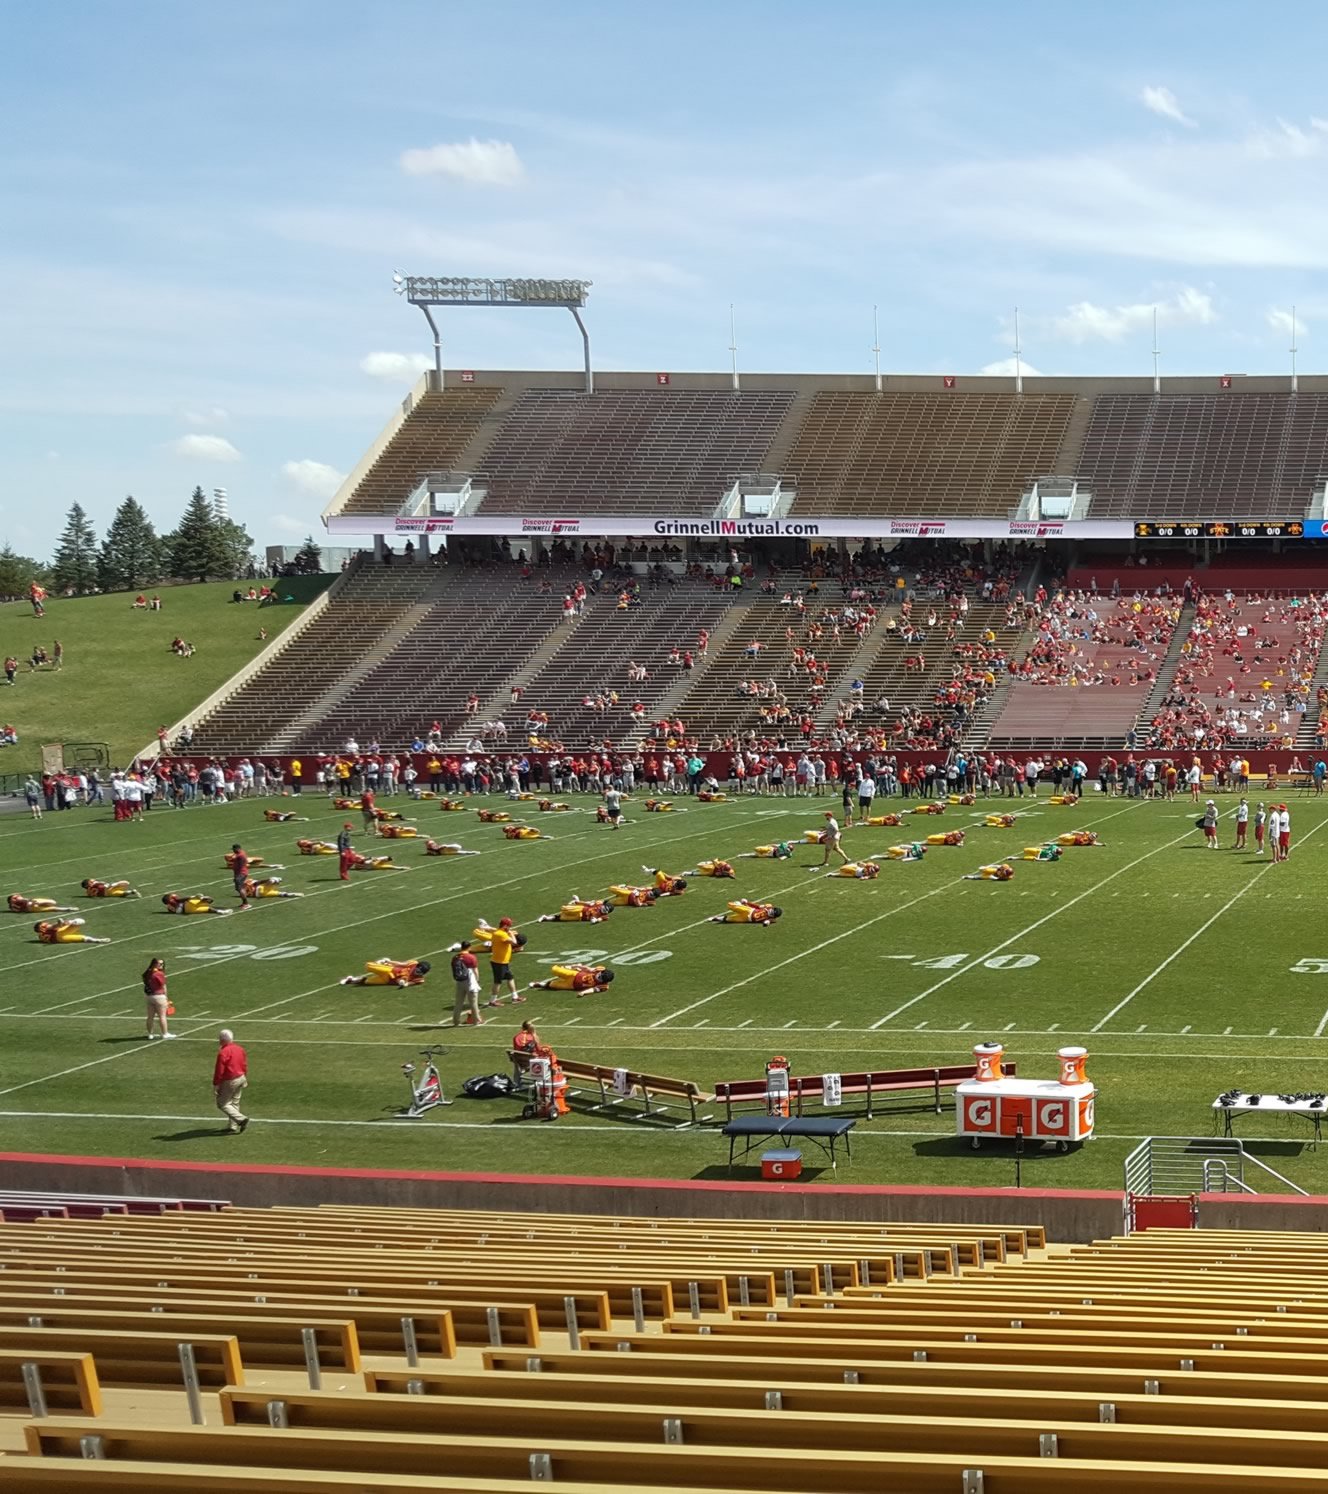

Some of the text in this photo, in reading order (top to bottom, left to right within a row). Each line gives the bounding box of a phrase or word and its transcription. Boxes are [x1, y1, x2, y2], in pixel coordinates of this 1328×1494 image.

[654, 520, 819, 534] GrinnellMutual.com
[1158, 528, 1173, 536] 0/0
[1184, 528, 1199, 536] 0/0
[1242, 527, 1281, 536] 0/0 0/0
[911, 953, 1041, 970] 40
[979, 1058, 989, 1069] G
[1064, 1061, 1075, 1073] G
[968, 1100, 992, 1126] G
[1040, 1103, 1064, 1129] G
[772, 1163, 783, 1174] G
